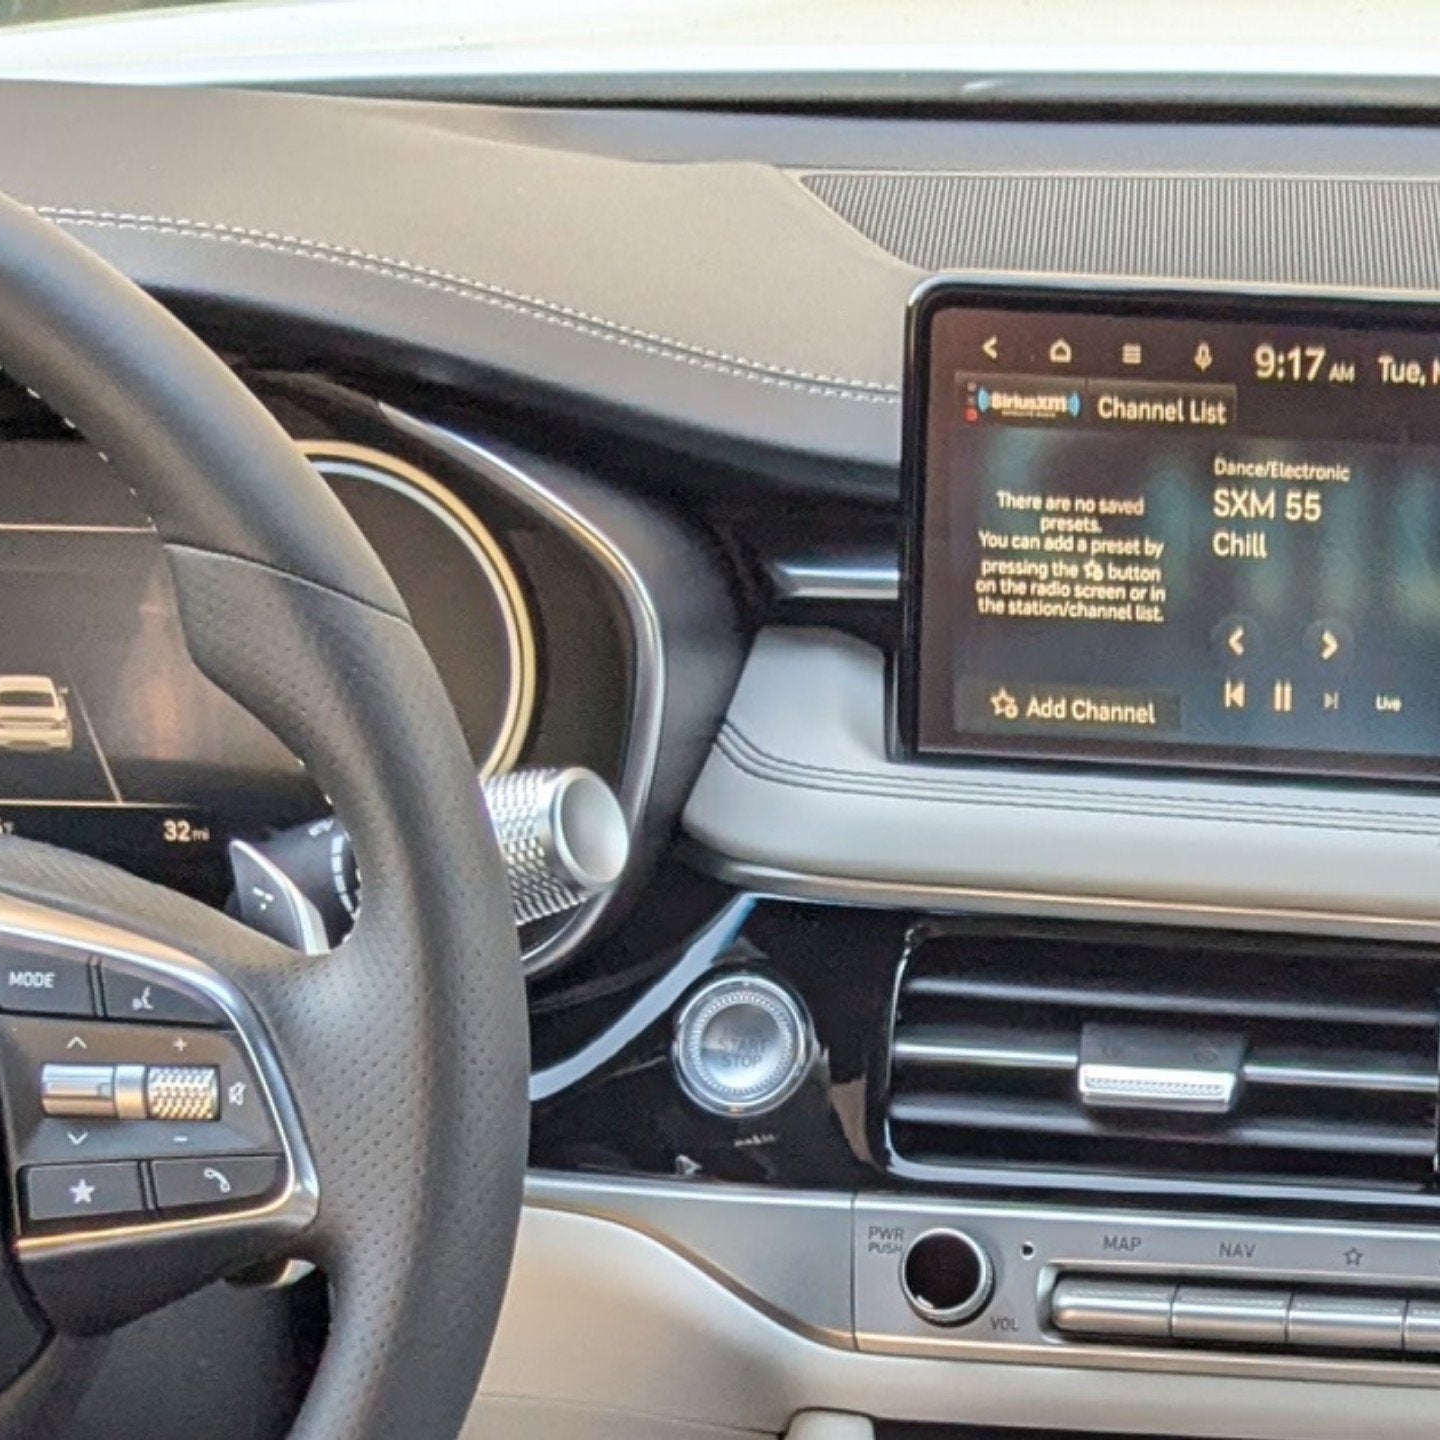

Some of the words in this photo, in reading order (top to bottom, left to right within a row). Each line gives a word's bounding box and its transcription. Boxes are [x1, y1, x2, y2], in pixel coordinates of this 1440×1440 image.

[1254, 344, 1326, 381] 9:17
[1328, 361, 1355, 383] AM
[1377, 355, 1426, 387] Tue,
[1096, 396, 1184, 422] Channel
[1190, 400, 1227, 426] List
[1213, 457, 1351, 482] Dance/Electronic
[996, 489, 1042, 511] There
[1045, 498, 1071, 513] are
[1075, 498, 1096, 513] no
[1099, 497, 1145, 516] saved
[1212, 488, 1277, 520] SXM
[1284, 490, 1322, 522] 55
[1039, 516, 1103, 534] presets.
[978, 529, 1009, 549] You
[1012, 534, 1040, 550] can
[1044, 535, 1074, 553] add
[1076, 539, 1087, 552] a
[1090, 538, 1141, 557] preset
[1144, 537, 1165, 559] by
[1212, 530, 1267, 559] Chill
[980, 558, 1048, 580] pressing
[1052, 561, 1078, 578] the
[1108, 562, 1162, 583] button
[975, 579, 996, 594] on
[1000, 579, 1027, 596] the
[1030, 581, 1070, 598] radio
[1074, 585, 1126, 601] screen
[1129, 587, 1147, 602] or
[1150, 587, 1166, 604] in
[978, 598, 1004, 616] the
[1009, 599, 1132, 622] station/channel
[1135, 604, 1165, 623] list.
[1025, 694, 1066, 719] Add
[1071, 698, 1156, 725] Channel
[9, 971, 56, 989] MODE
[868, 1225, 906, 1241] PWR
[1103, 1235, 1142, 1253] MAP
[1219, 1241, 1257, 1260] NAV
[990, 1317, 1020, 1332] VOL
